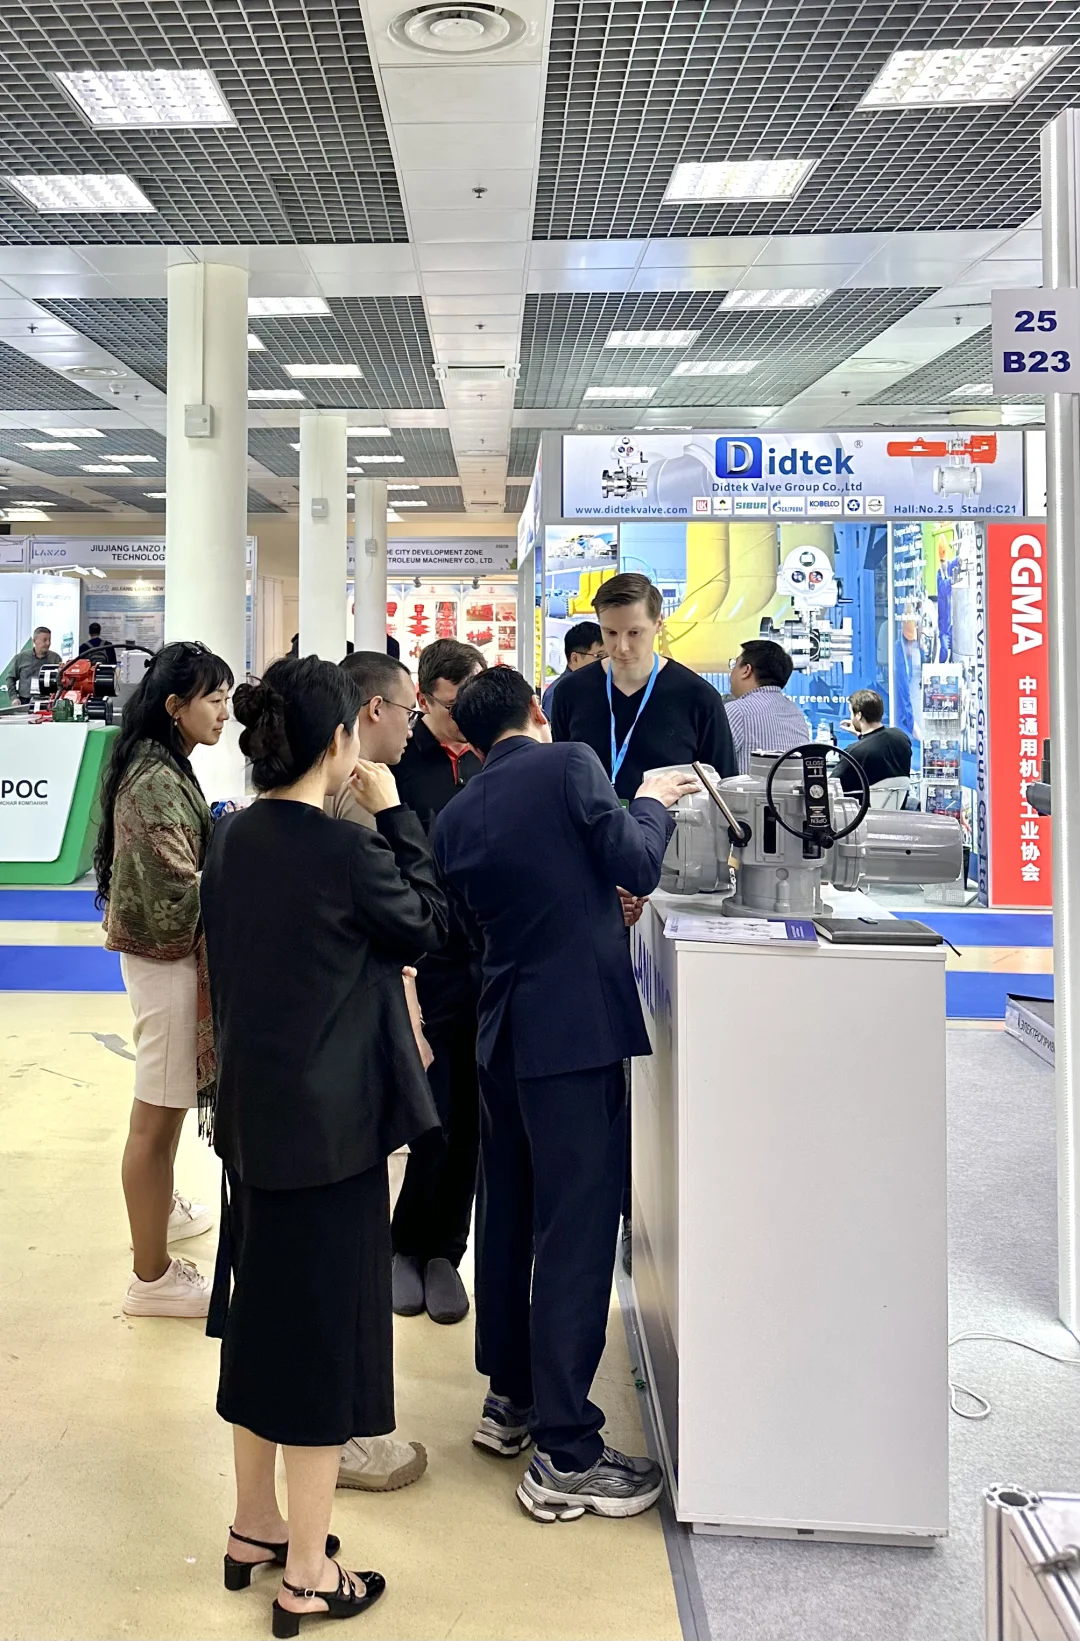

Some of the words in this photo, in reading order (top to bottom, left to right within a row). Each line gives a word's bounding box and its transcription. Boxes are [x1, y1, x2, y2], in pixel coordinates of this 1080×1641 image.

[1014, 310, 1058, 333] 25
[1003, 350, 1072, 373] B23
[725, 439, 855, 476] Didtek
[712, 483, 749, 492] Didtek
[752, 483, 782, 492] Valve
[784, 483, 820, 495] Group
[822, 482, 863, 494] Co.,Ltd
[735, 502, 767, 510] SIBUR
[809, 500, 840, 508] KOBELCO
[961, 504, 1017, 514] Stand:C21
[575, 505, 688, 515] www.didtekvalve.com
[34, 549, 67, 557] LANZO
[90, 545, 130, 553] JIUJIANG
[131, 545, 161, 553] LANZO
[112, 553, 166, 562] TECHNOLOG
[975, 534, 984, 621] Didtek
[1010, 534, 1043, 655] CGMA
[976, 628, 985, 701] Valve
[798, 695, 830, 705] green
[977, 708, 986, 792] Group
